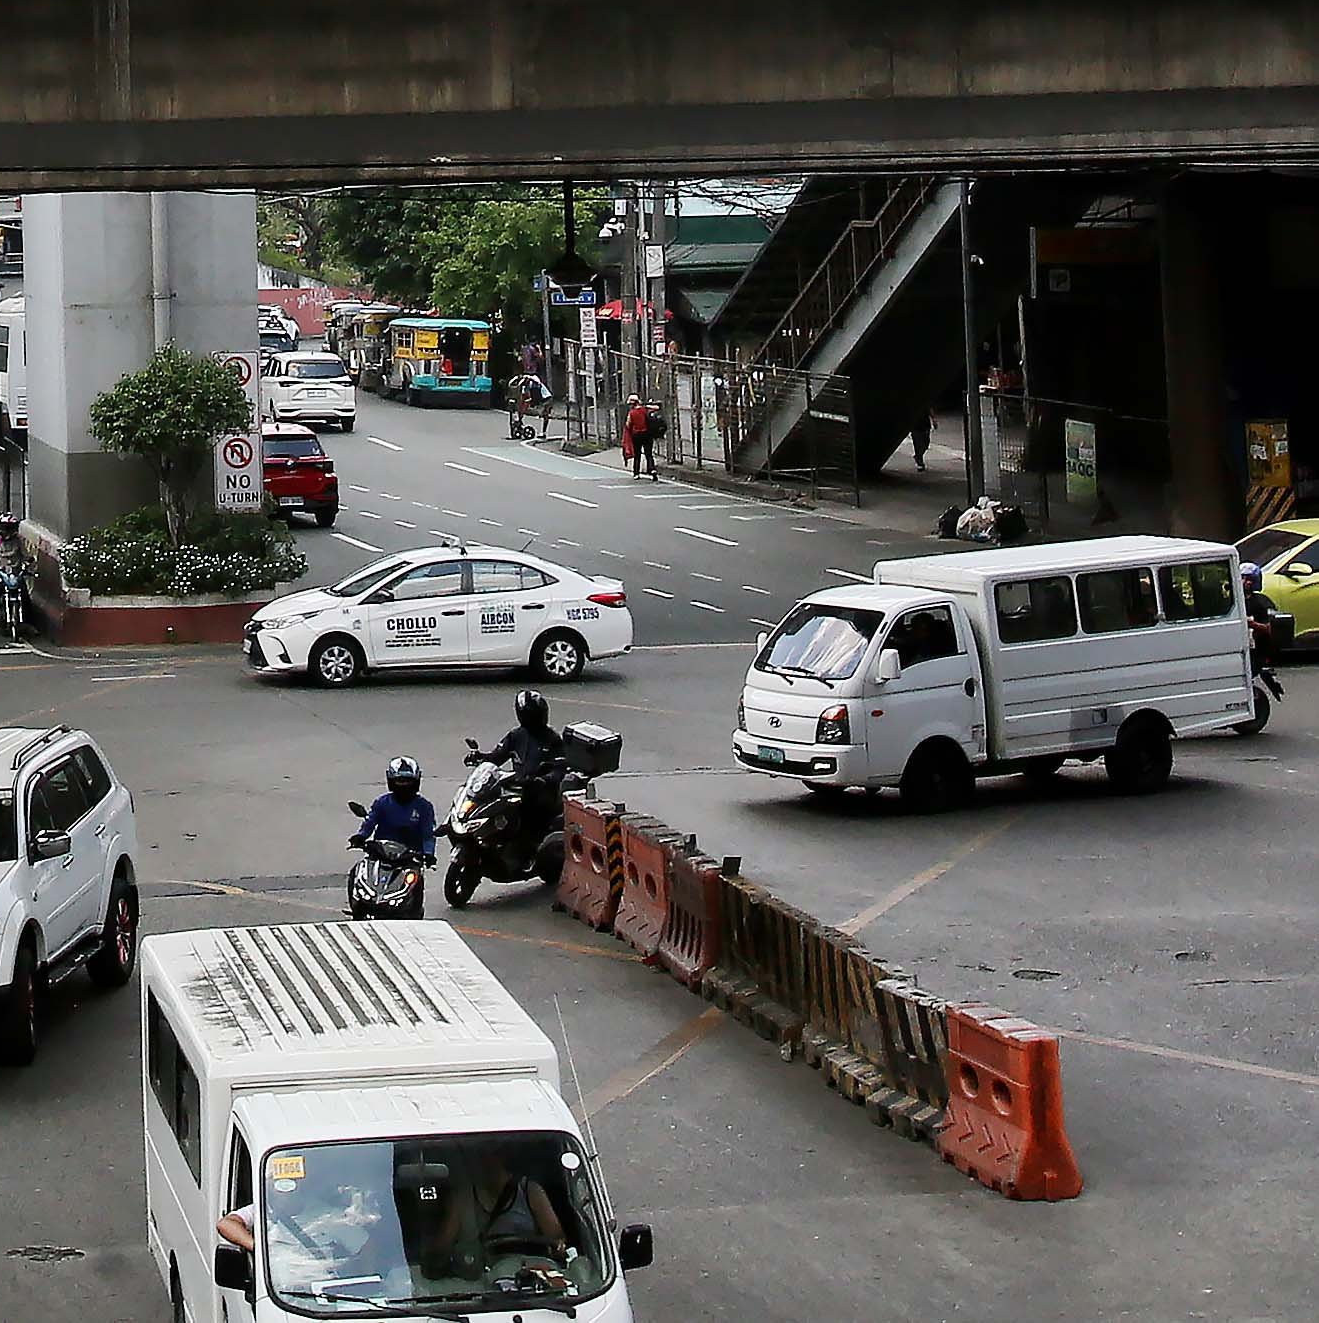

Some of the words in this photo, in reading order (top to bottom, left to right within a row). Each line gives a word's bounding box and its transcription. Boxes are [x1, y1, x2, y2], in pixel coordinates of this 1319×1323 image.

[226, 474, 251, 489] NO
[219, 491, 259, 504] U-TURN
[386, 616, 437, 631] CHOLLO
[481, 612, 515, 625] AIRCON
